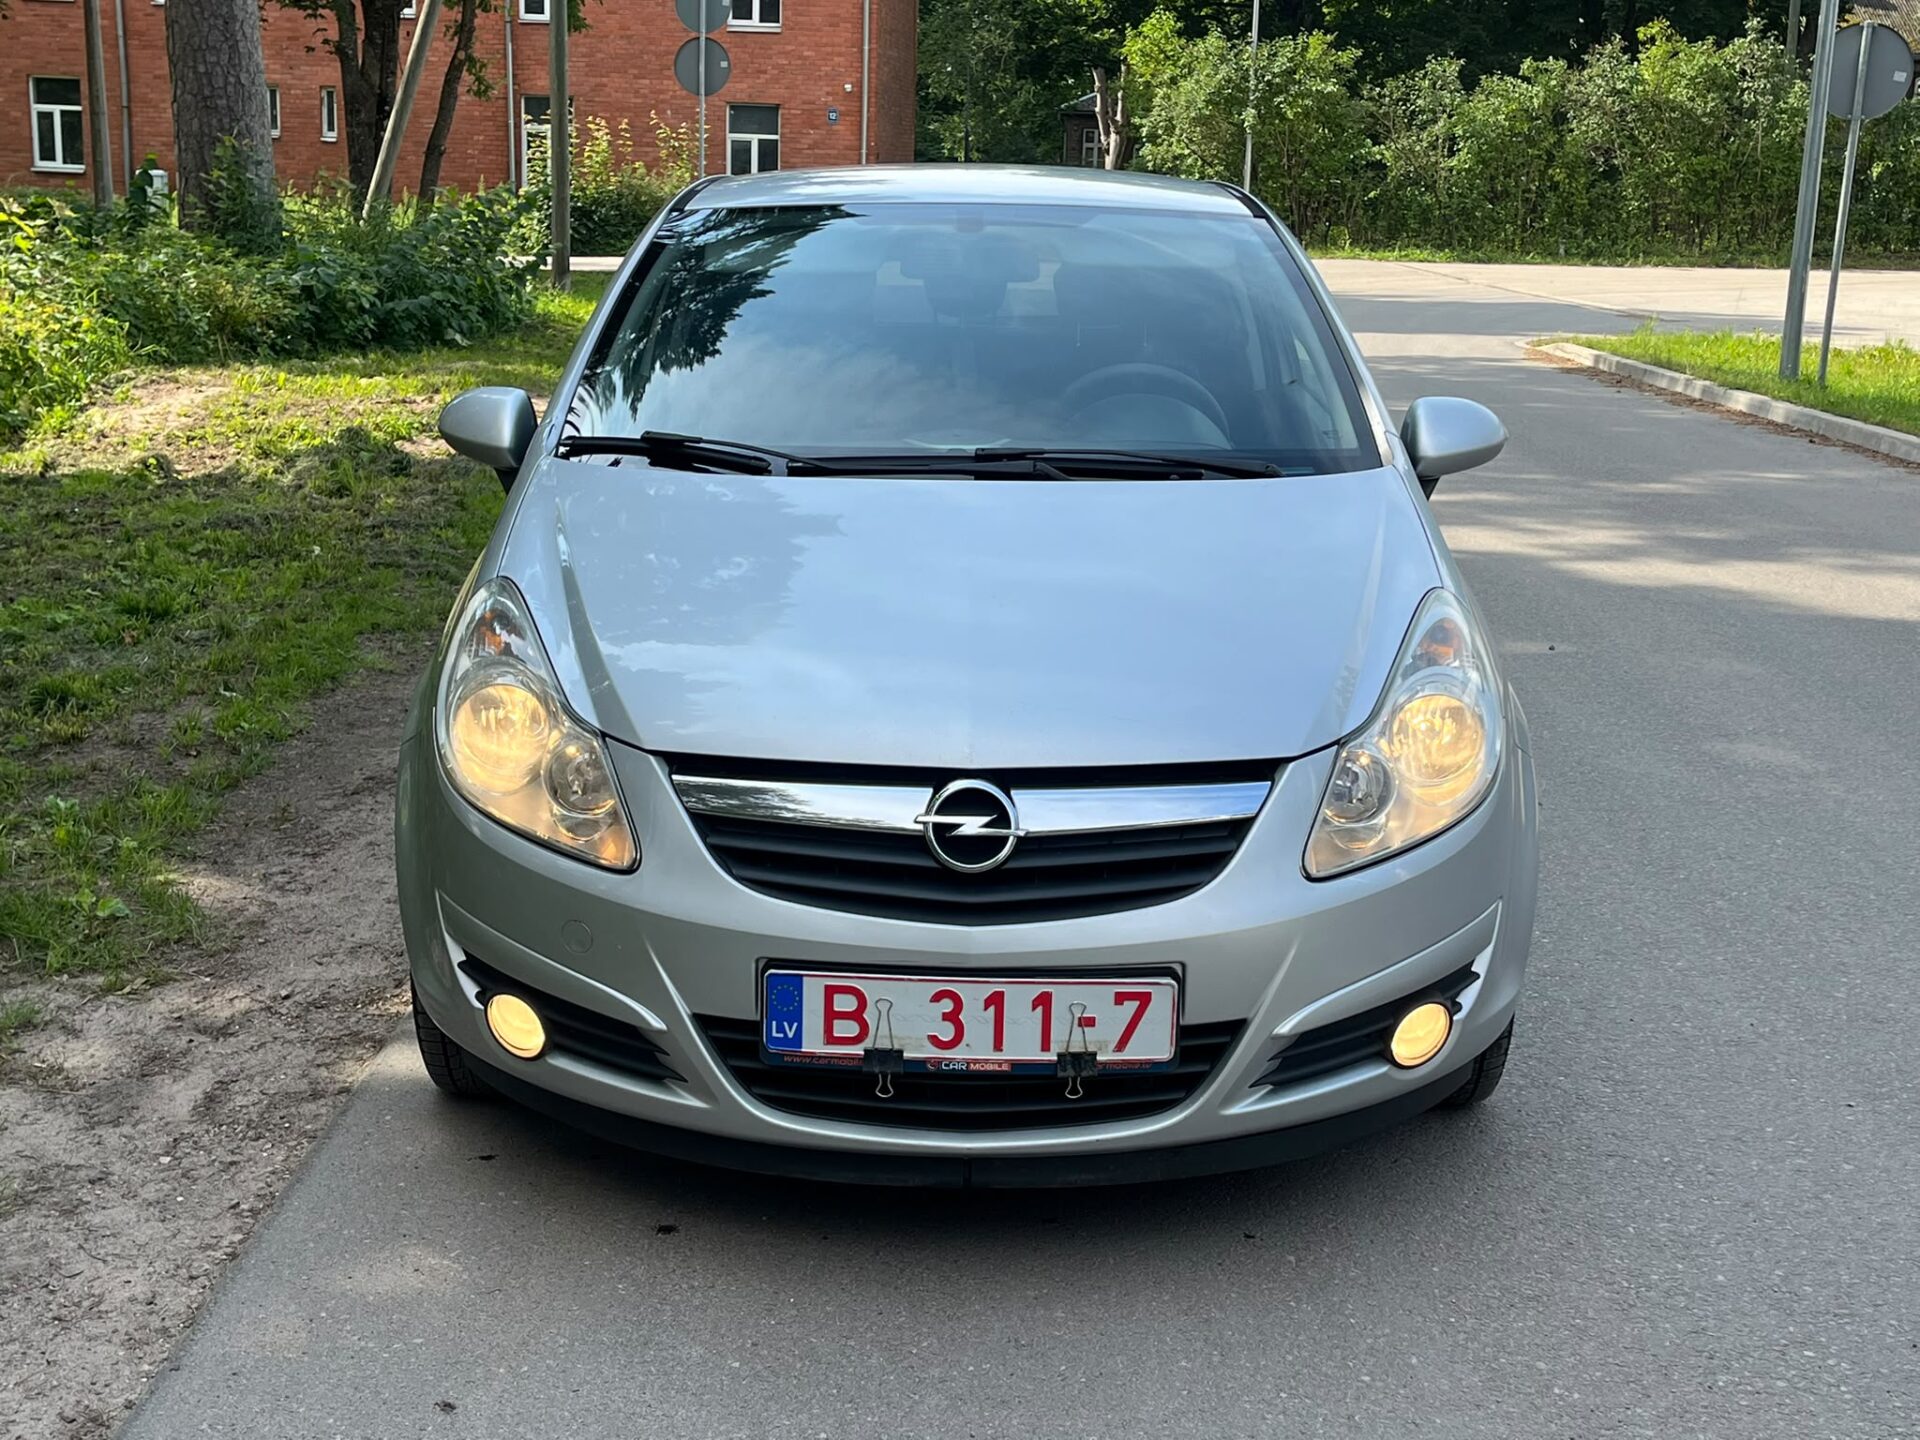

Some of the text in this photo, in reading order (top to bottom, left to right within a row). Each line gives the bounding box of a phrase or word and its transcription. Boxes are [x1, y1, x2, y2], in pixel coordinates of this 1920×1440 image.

[823, 984, 1153, 1053] B 311-7
[771, 1020, 798, 1038] LV
[941, 1061, 1009, 1071] CAR MOBILE
